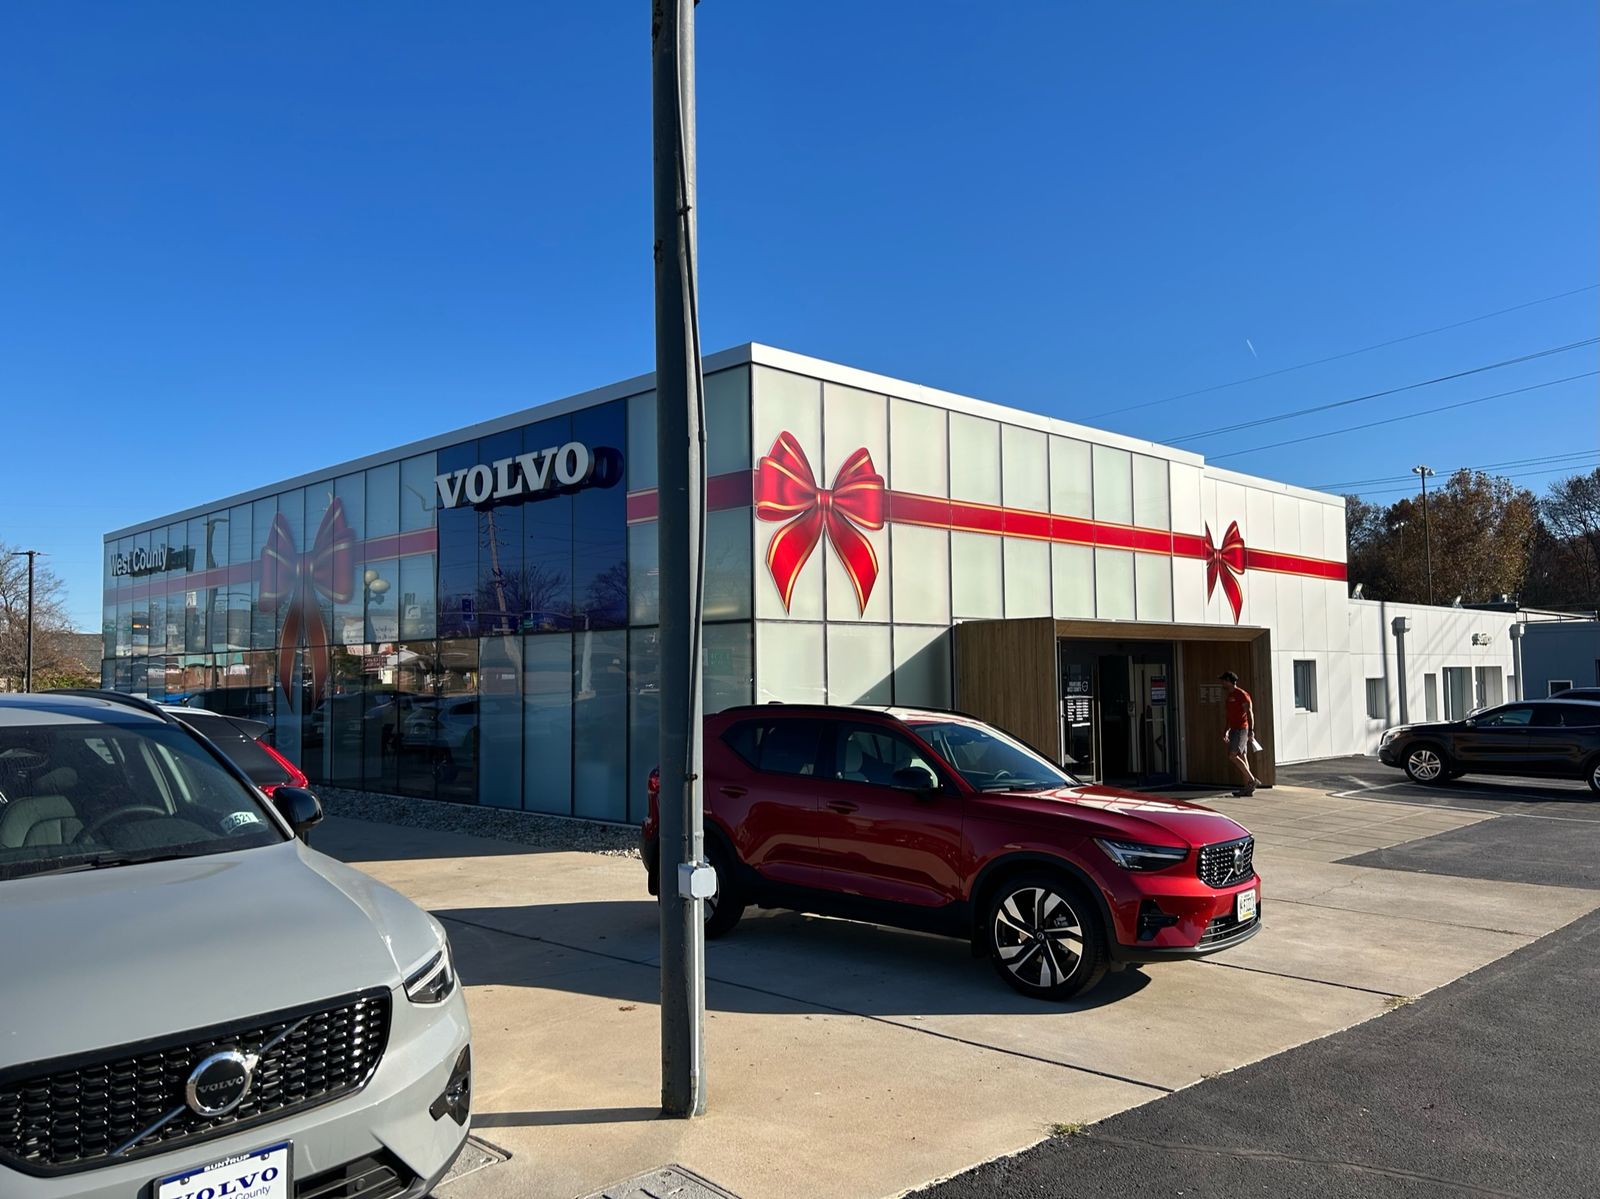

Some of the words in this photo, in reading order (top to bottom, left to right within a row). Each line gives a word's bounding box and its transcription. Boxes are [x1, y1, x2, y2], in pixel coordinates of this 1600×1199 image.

[434, 441, 589, 509] VOLVO
[133, 543, 168, 571] County
[198, 1076, 244, 1093] VOLVO
